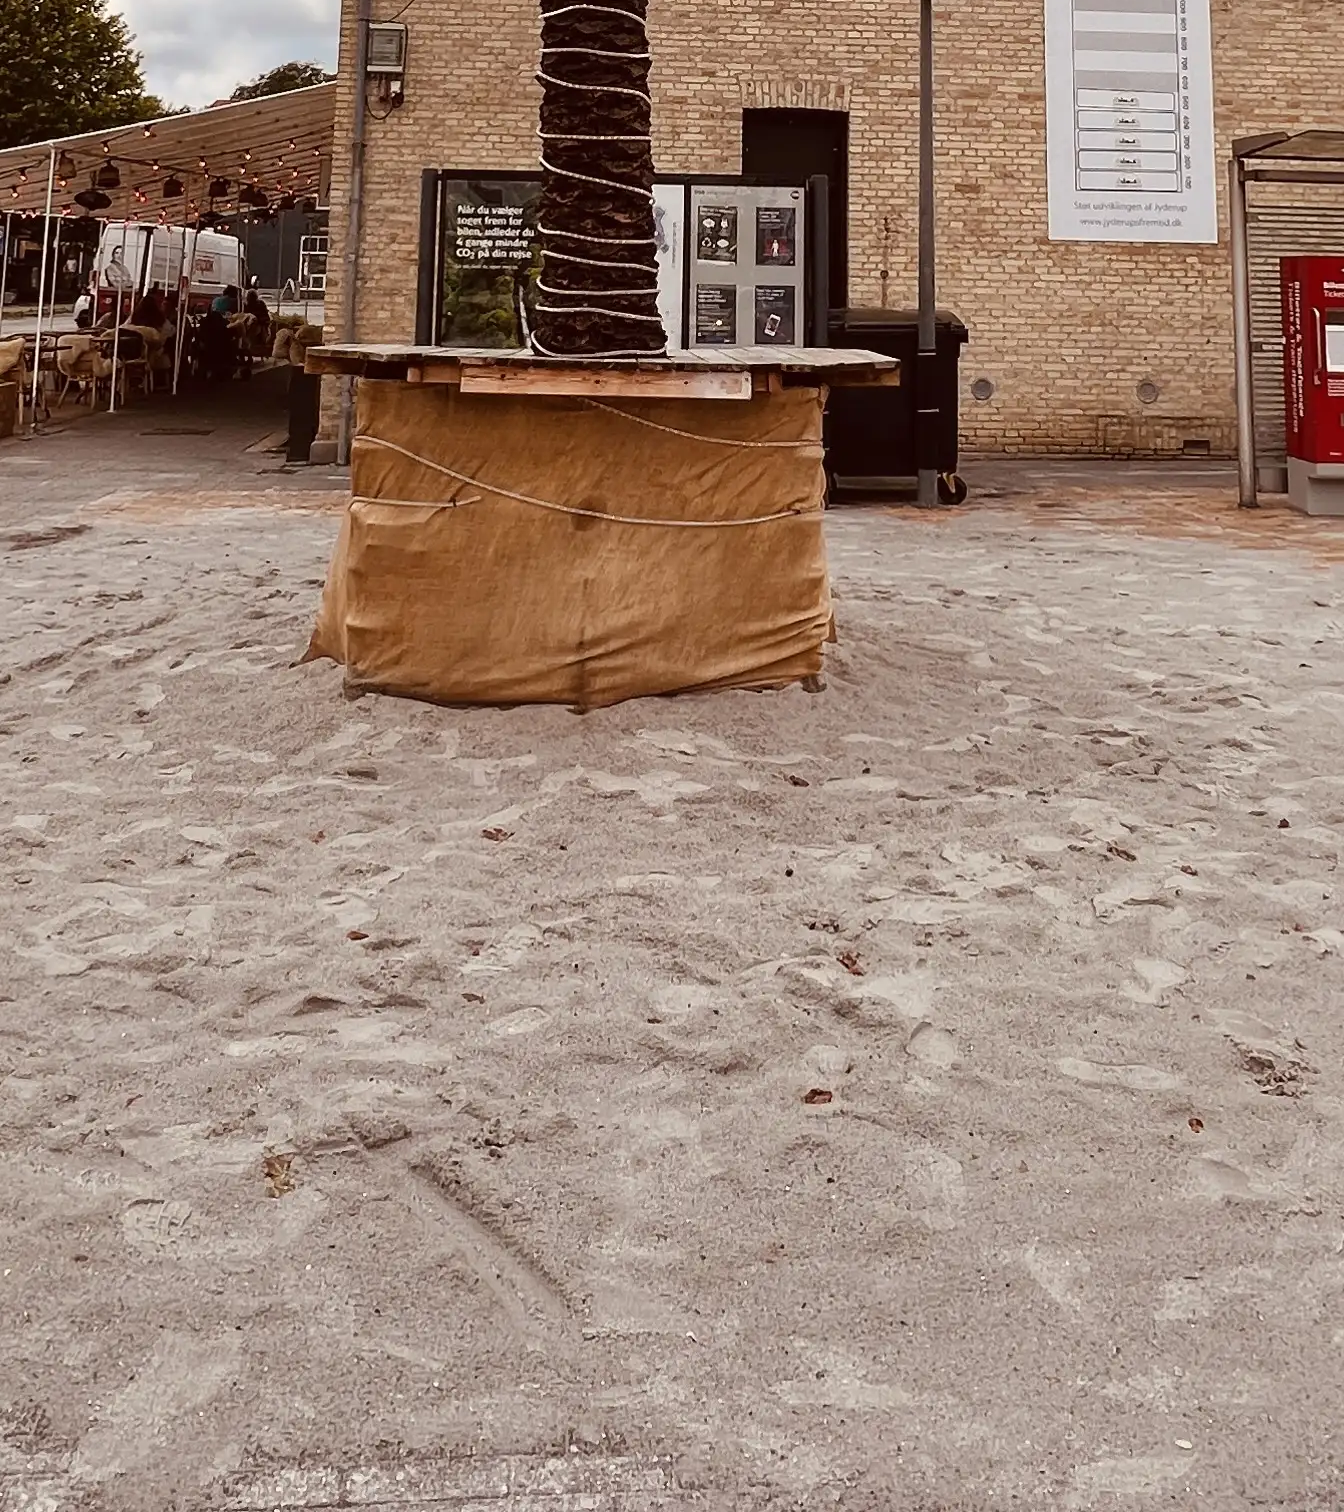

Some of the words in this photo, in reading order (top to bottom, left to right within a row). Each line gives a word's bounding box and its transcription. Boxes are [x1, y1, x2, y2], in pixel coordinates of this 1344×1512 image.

[457, 204, 475, 214] Når
[477, 205, 489, 214] du
[491, 206, 524, 216] vælger
[457, 217, 482, 226] toget
[484, 216, 507, 225] frem
[509, 216, 523, 225] for
[457, 227, 483, 236] bilen,
[484, 227, 520, 236] udleder
[522, 227, 535, 237] du
[456, 237, 463, 246] 4
[465, 239, 493, 247] gange
[495, 238, 528, 247] mindre
[477, 248, 490, 259] på
[492, 249, 507, 258] din
[509, 250, 532, 259] rejse
